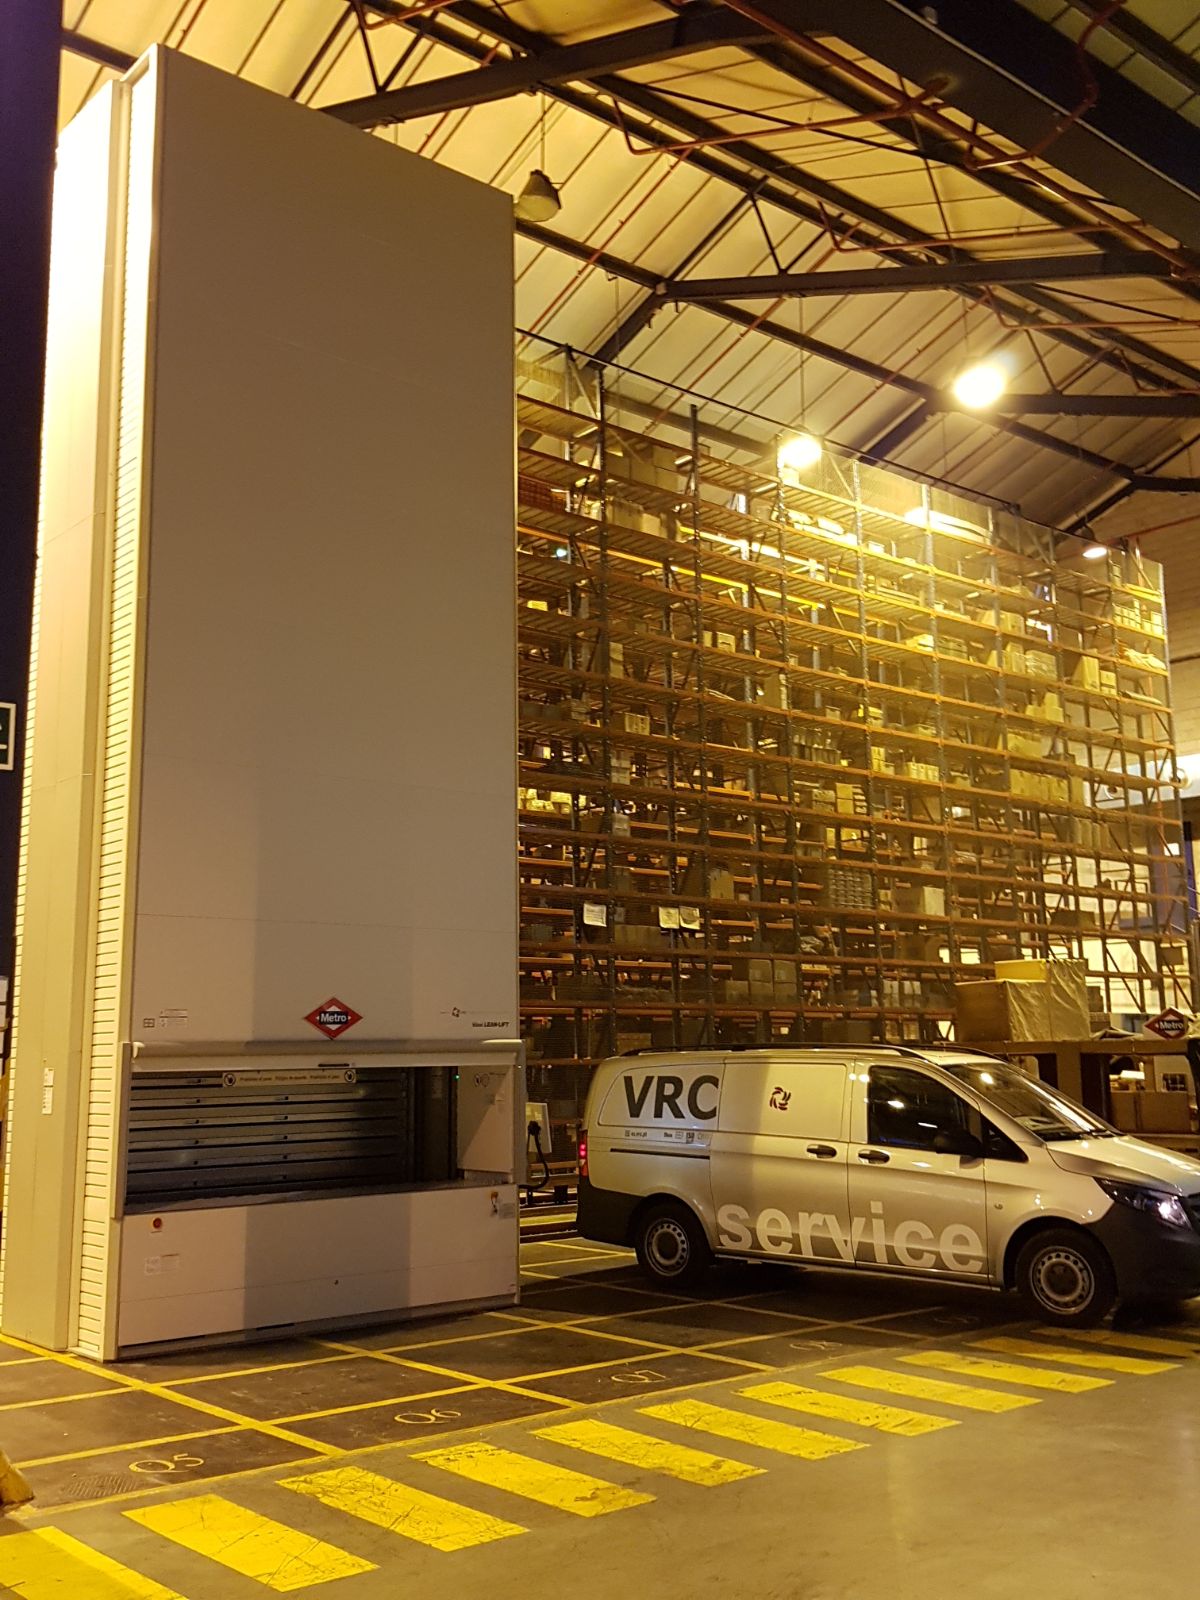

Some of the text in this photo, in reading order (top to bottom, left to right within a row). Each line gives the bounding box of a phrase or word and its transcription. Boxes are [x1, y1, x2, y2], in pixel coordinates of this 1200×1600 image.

[320, 1013, 347, 1023] Metro
[1159, 1021, 1184, 1030] Metro
[623, 1075, 720, 1120] VRC
[716, 1200, 985, 1273] service
